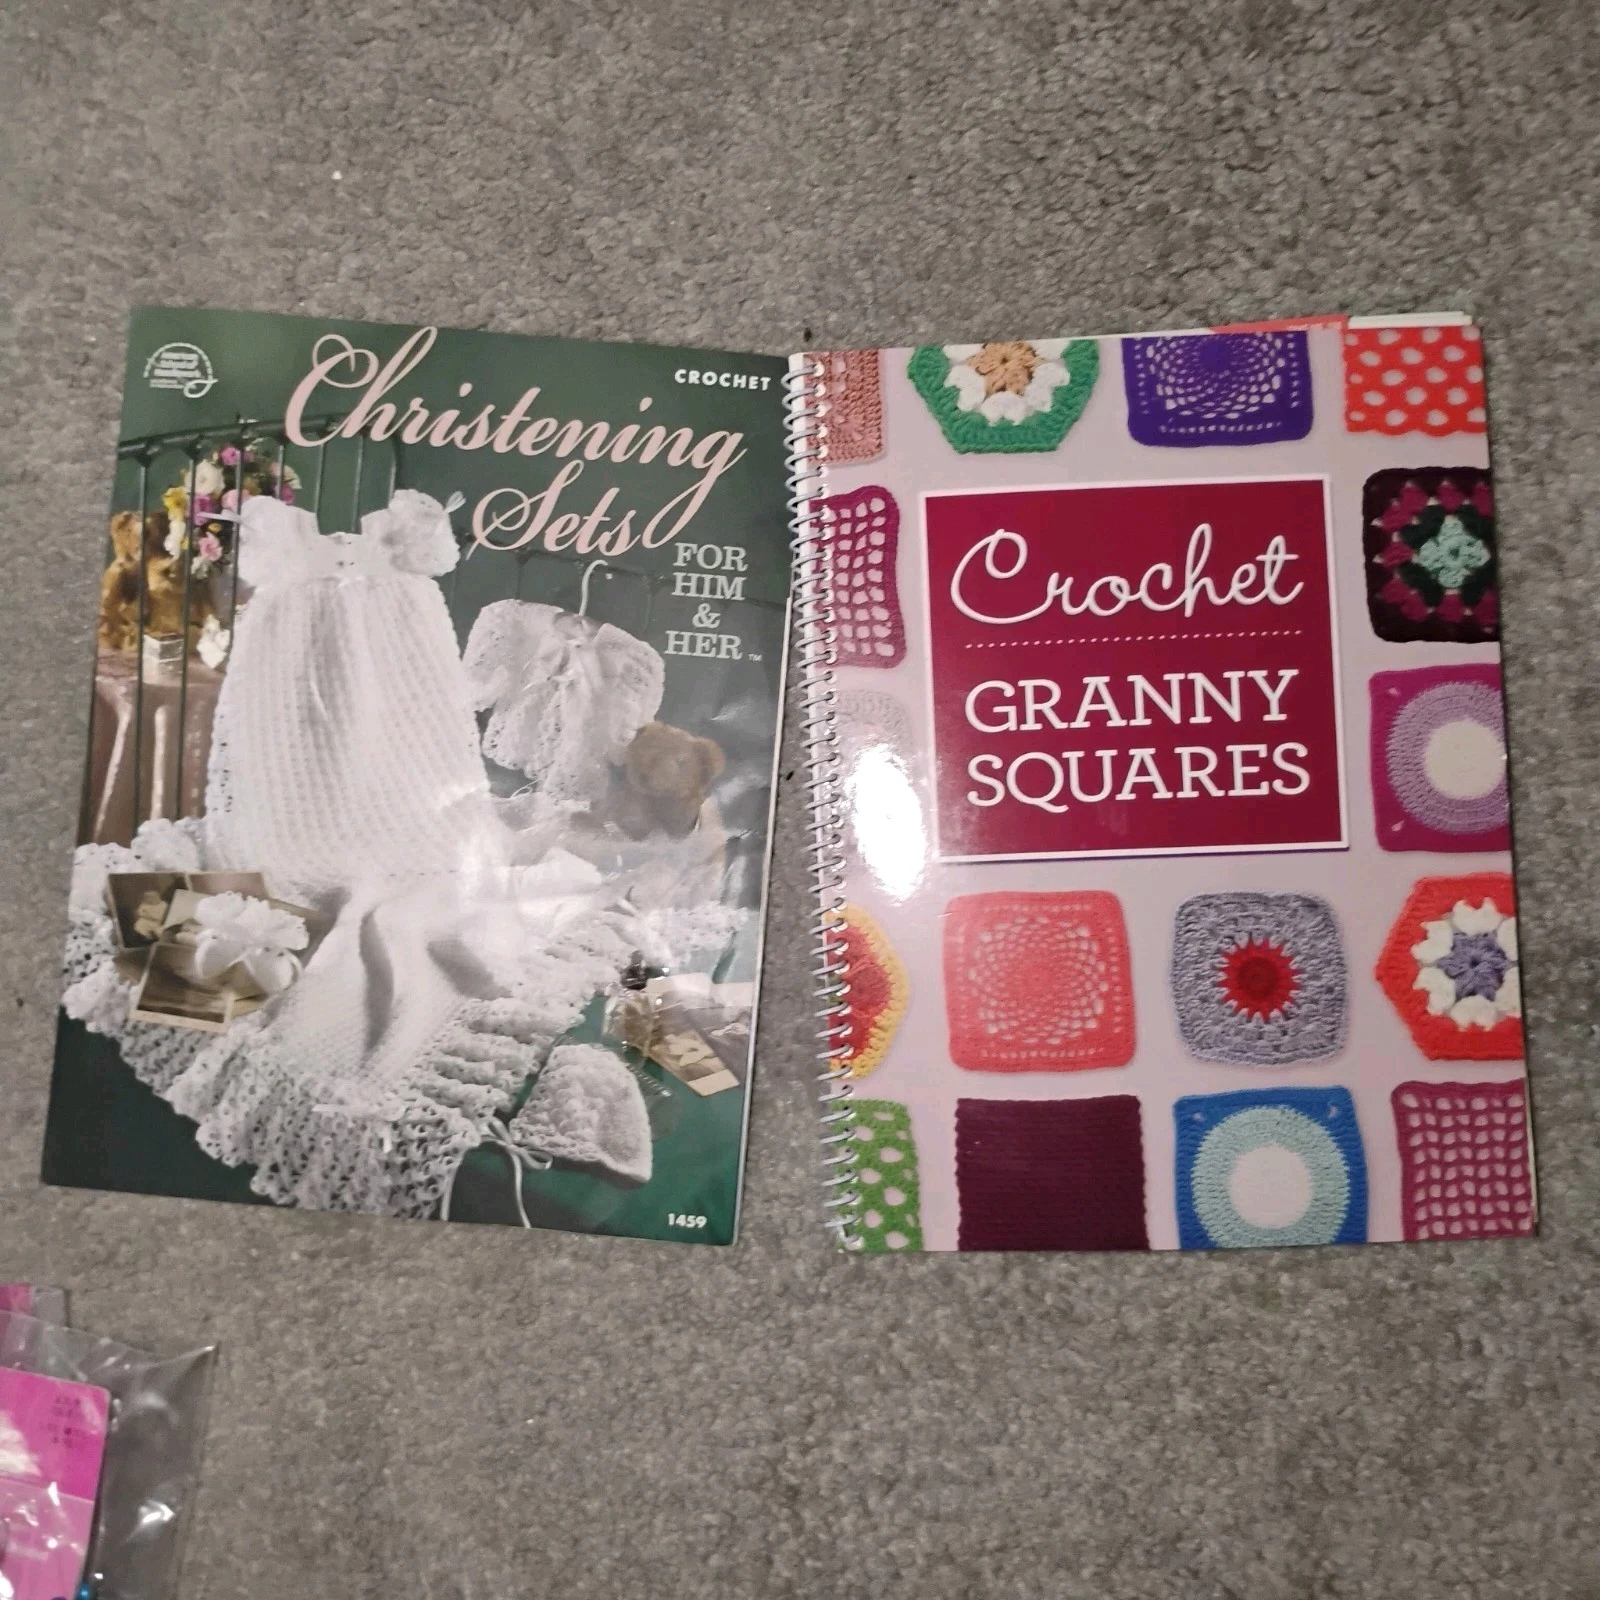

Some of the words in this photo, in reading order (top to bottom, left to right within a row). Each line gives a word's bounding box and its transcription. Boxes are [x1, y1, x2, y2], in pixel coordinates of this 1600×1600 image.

[674, 368, 771, 391] CROCHET
[285, 326, 748, 549] Christening
[465, 459, 641, 560] Sets
[672, 542, 748, 572] FOR
[671, 571, 747, 601] HIM
[950, 523, 1305, 625] Crochet
[691, 602, 721, 629] &
[663, 630, 743, 660] HER
[964, 669, 1299, 734] GRANNY
[966, 742, 1311, 814] SQUARES
[667, 1212, 708, 1229] 1459
